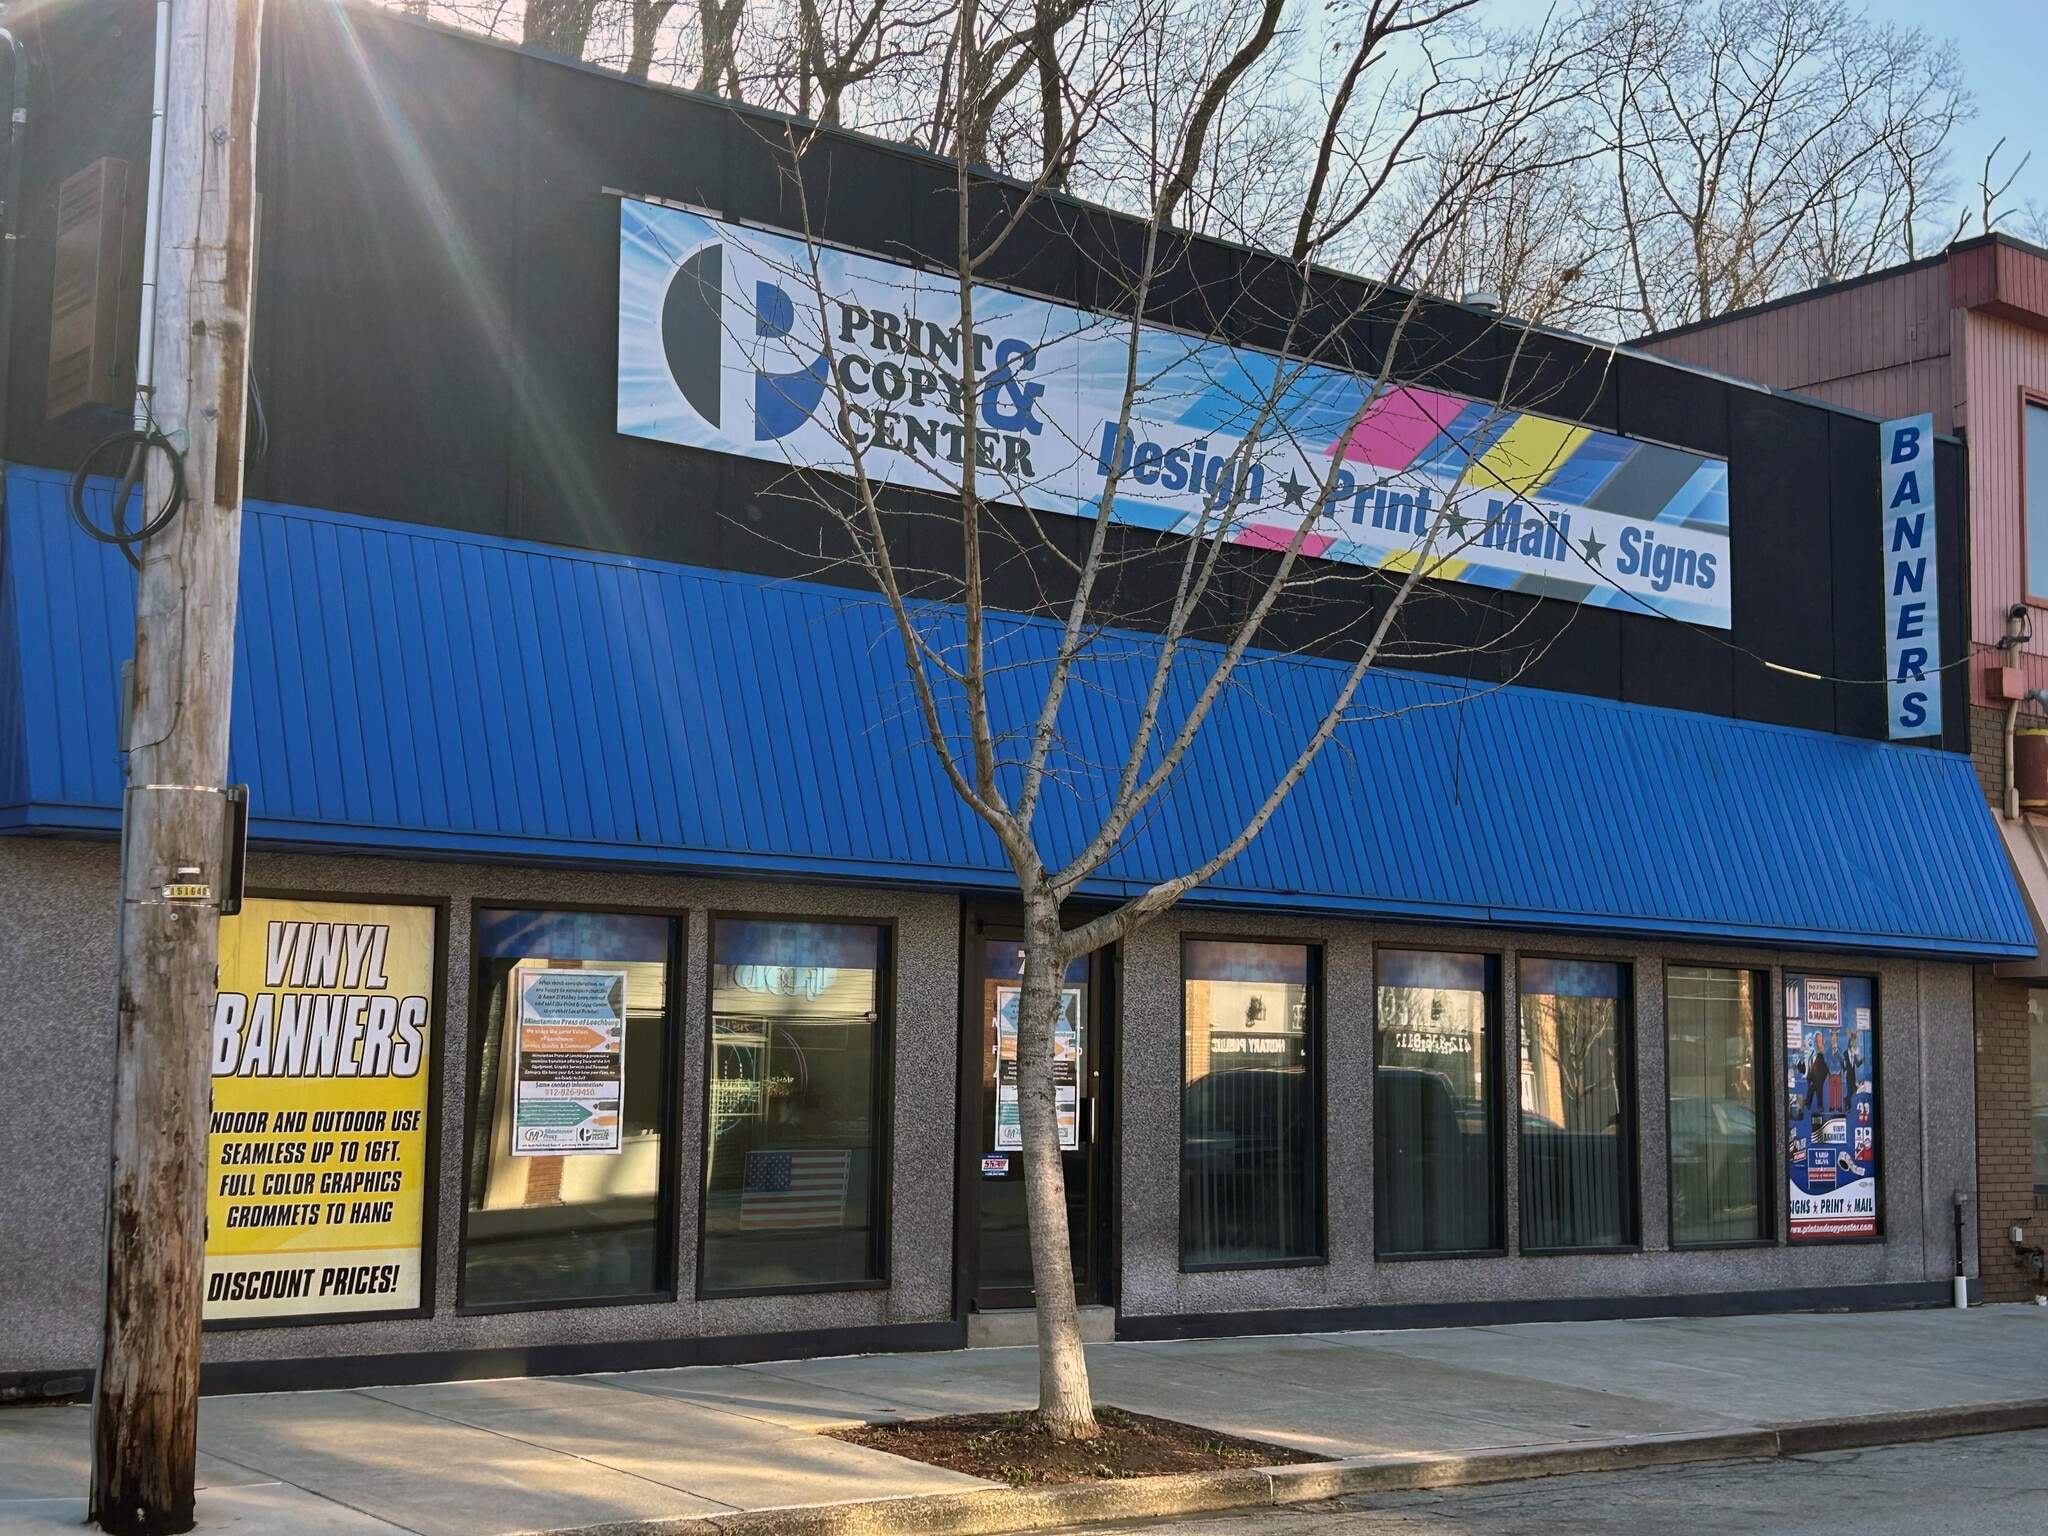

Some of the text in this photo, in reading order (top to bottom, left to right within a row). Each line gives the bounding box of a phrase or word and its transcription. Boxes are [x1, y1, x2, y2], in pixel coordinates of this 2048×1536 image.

[837, 354, 973, 415] COPY
[838, 304, 1045, 436] PRINT &
[837, 404, 1035, 478] CENTER
[1097, 420, 1717, 592] Design Print Mail Signs
[1889, 426, 1928, 728] BANNERS
[265, 920, 390, 989] VINYL
[211, 992, 428, 1078] BANNERS
[209, 1109, 421, 1133] NDOOR AND OUTDOOR USE
[221, 1140, 401, 1165] SEAMLESS UP TO 16FT.
[219, 1171, 403, 1197] FULL COLOR GRAPHICS
[226, 1201, 394, 1228] GROMMETS TO HANG
[1820, 1198, 1844, 1214] PRINT
[1854, 1197, 1872, 1213] MAIL
[207, 1264, 401, 1301] DISCOUNT PRICES!
